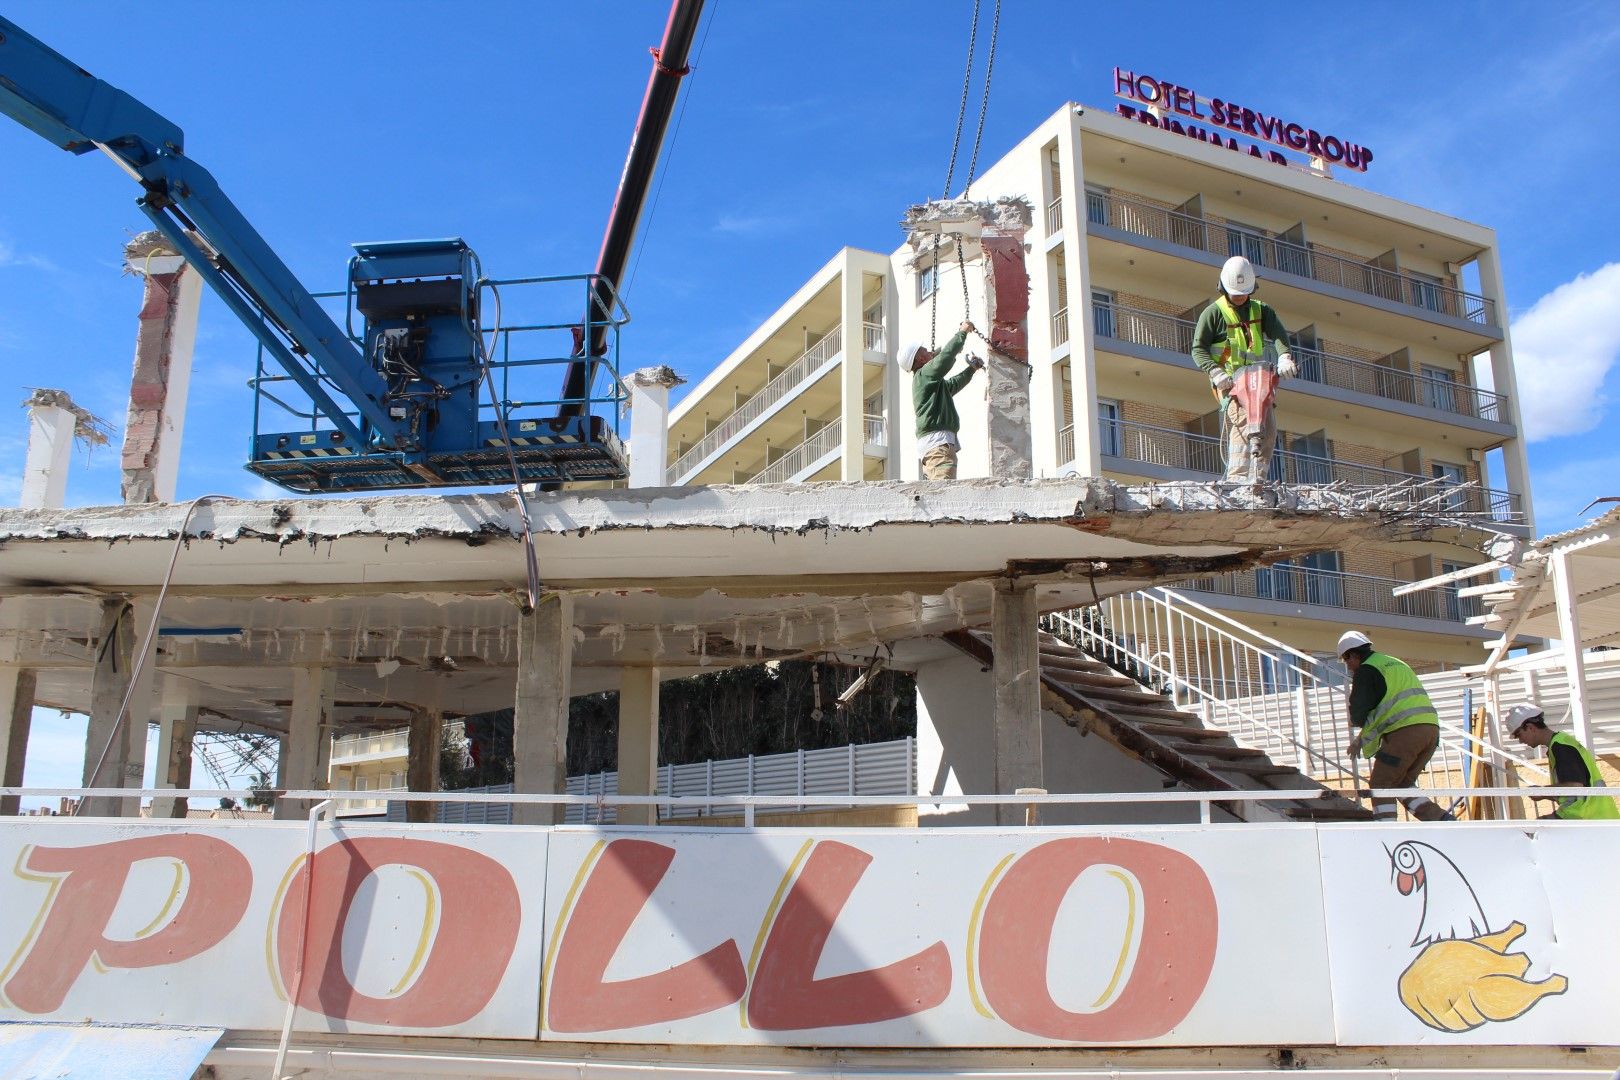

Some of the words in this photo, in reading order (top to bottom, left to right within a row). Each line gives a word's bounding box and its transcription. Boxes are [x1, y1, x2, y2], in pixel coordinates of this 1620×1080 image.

[1112, 66, 1205, 119] HOTEL
[1209, 98, 1373, 172] SERVIGROUP
[0, 832, 1219, 1042] POLLO
